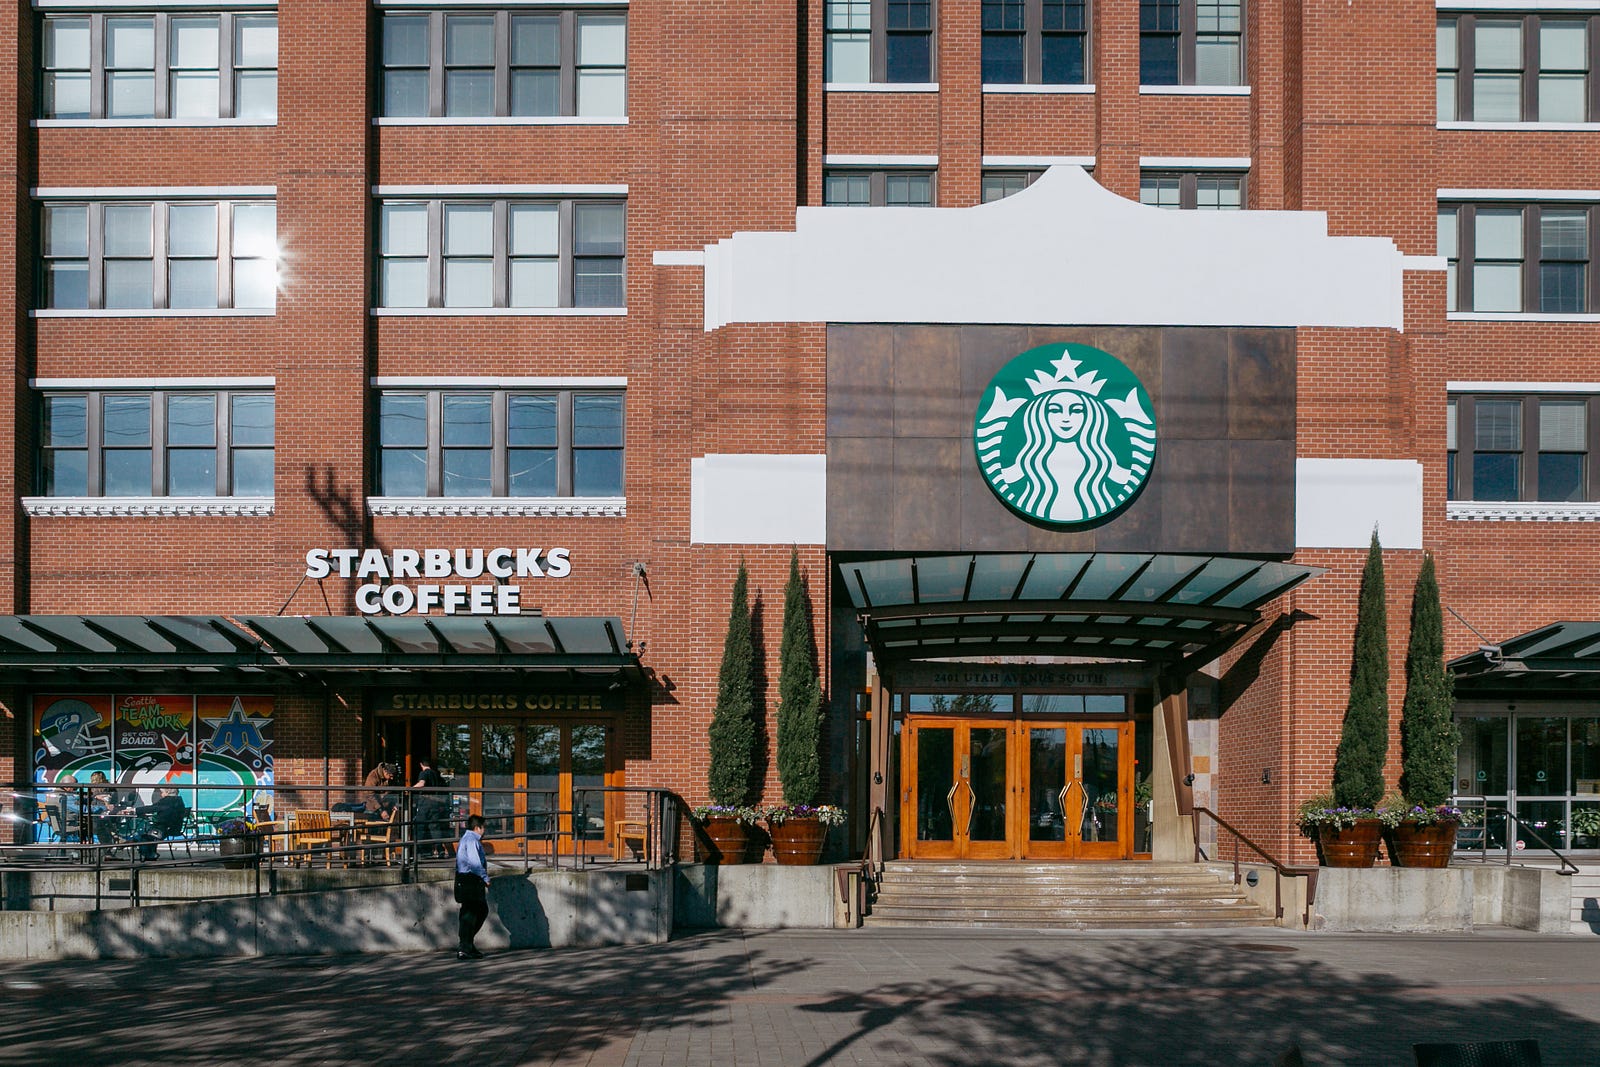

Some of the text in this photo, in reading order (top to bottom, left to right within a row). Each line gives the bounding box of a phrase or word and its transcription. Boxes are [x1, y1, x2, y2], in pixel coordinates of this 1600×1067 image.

[305, 547, 572, 578] STARBUCKS
[355, 584, 522, 614] COFFEE
[934, 672, 1104, 684] 2401 UTAH AVENUE SOUTH
[122, 696, 156, 707] Seattle
[392, 694, 602, 710] STARBUCKS COFFEE
[120, 703, 165, 721] TEAM-
[142, 713, 189, 731] WORK
